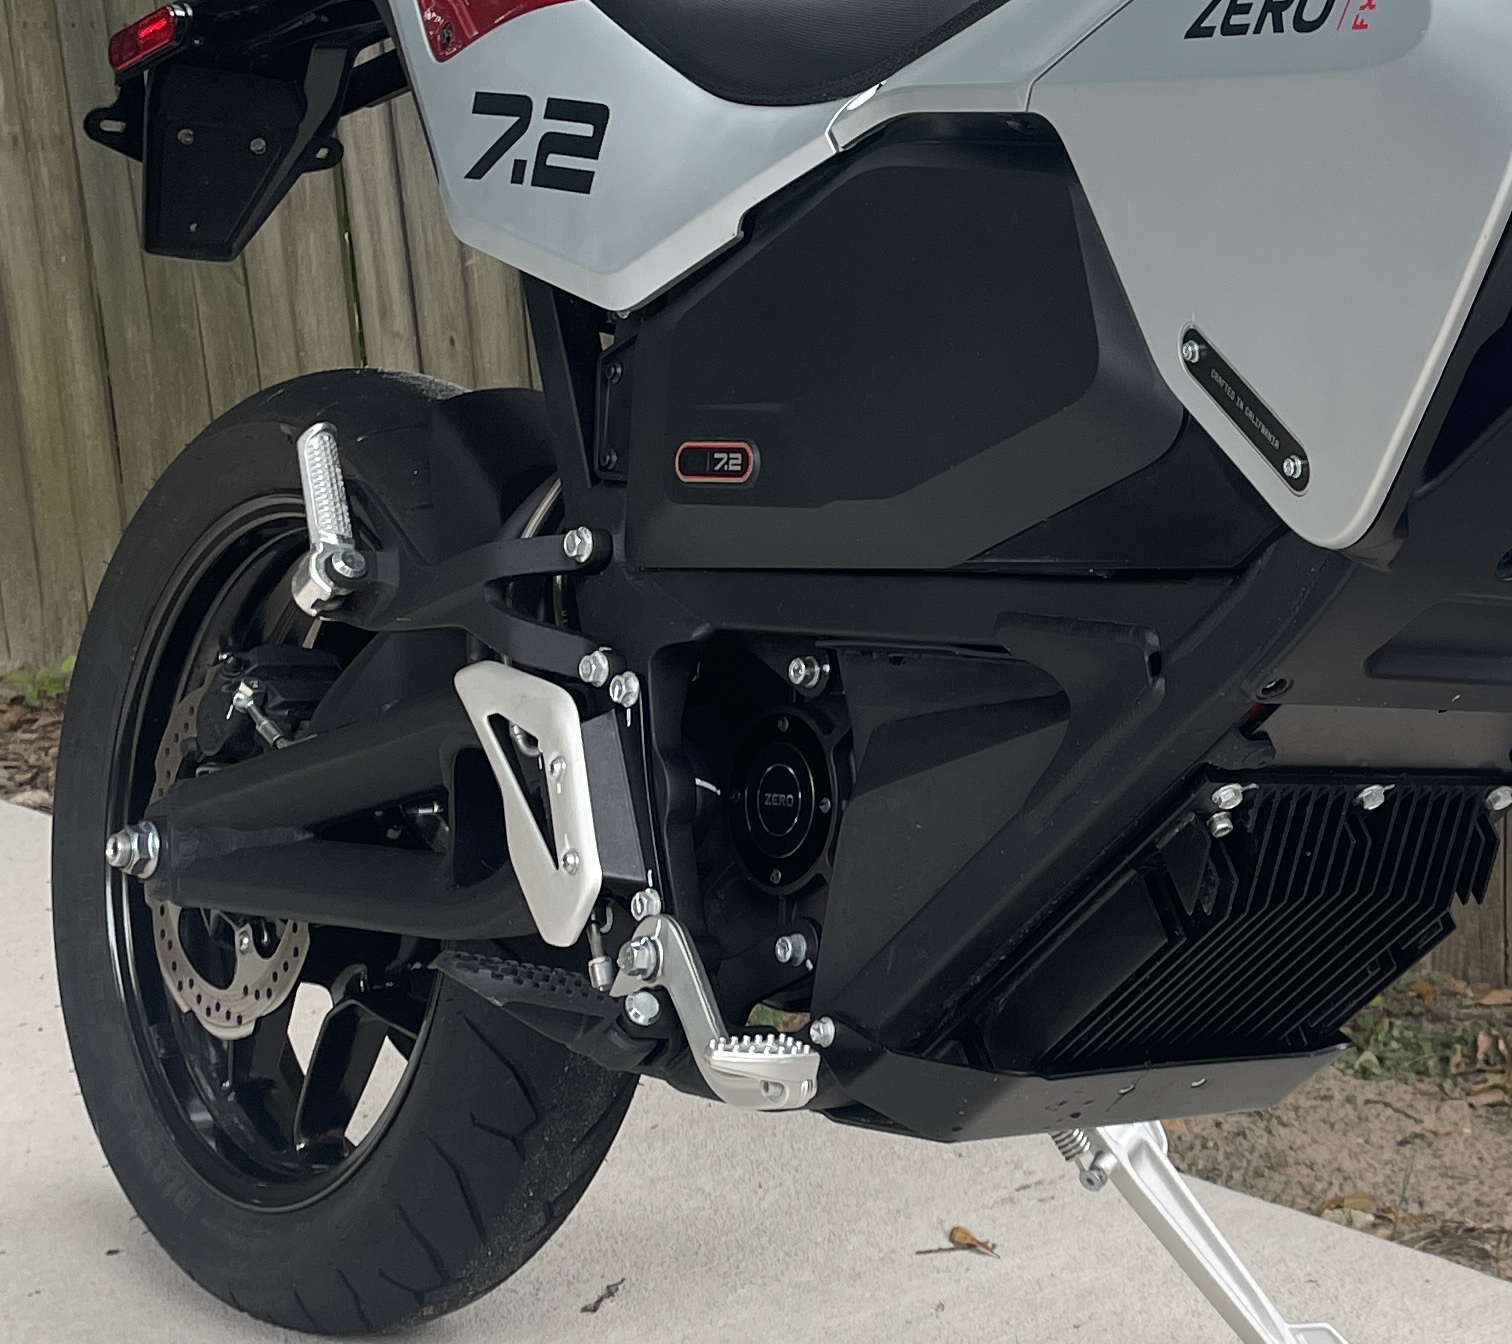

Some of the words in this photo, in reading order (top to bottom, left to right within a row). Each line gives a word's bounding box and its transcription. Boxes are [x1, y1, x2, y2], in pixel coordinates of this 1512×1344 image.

[463, 91, 610, 195] 7.2
[1210, 368, 1236, 401] CRAFTED
[1235, 396, 1245, 411] IN
[1244, 406, 1280, 450] CALIFORNIA
[713, 452, 742, 471] 7.2
[764, 792, 794, 807] ZERO
